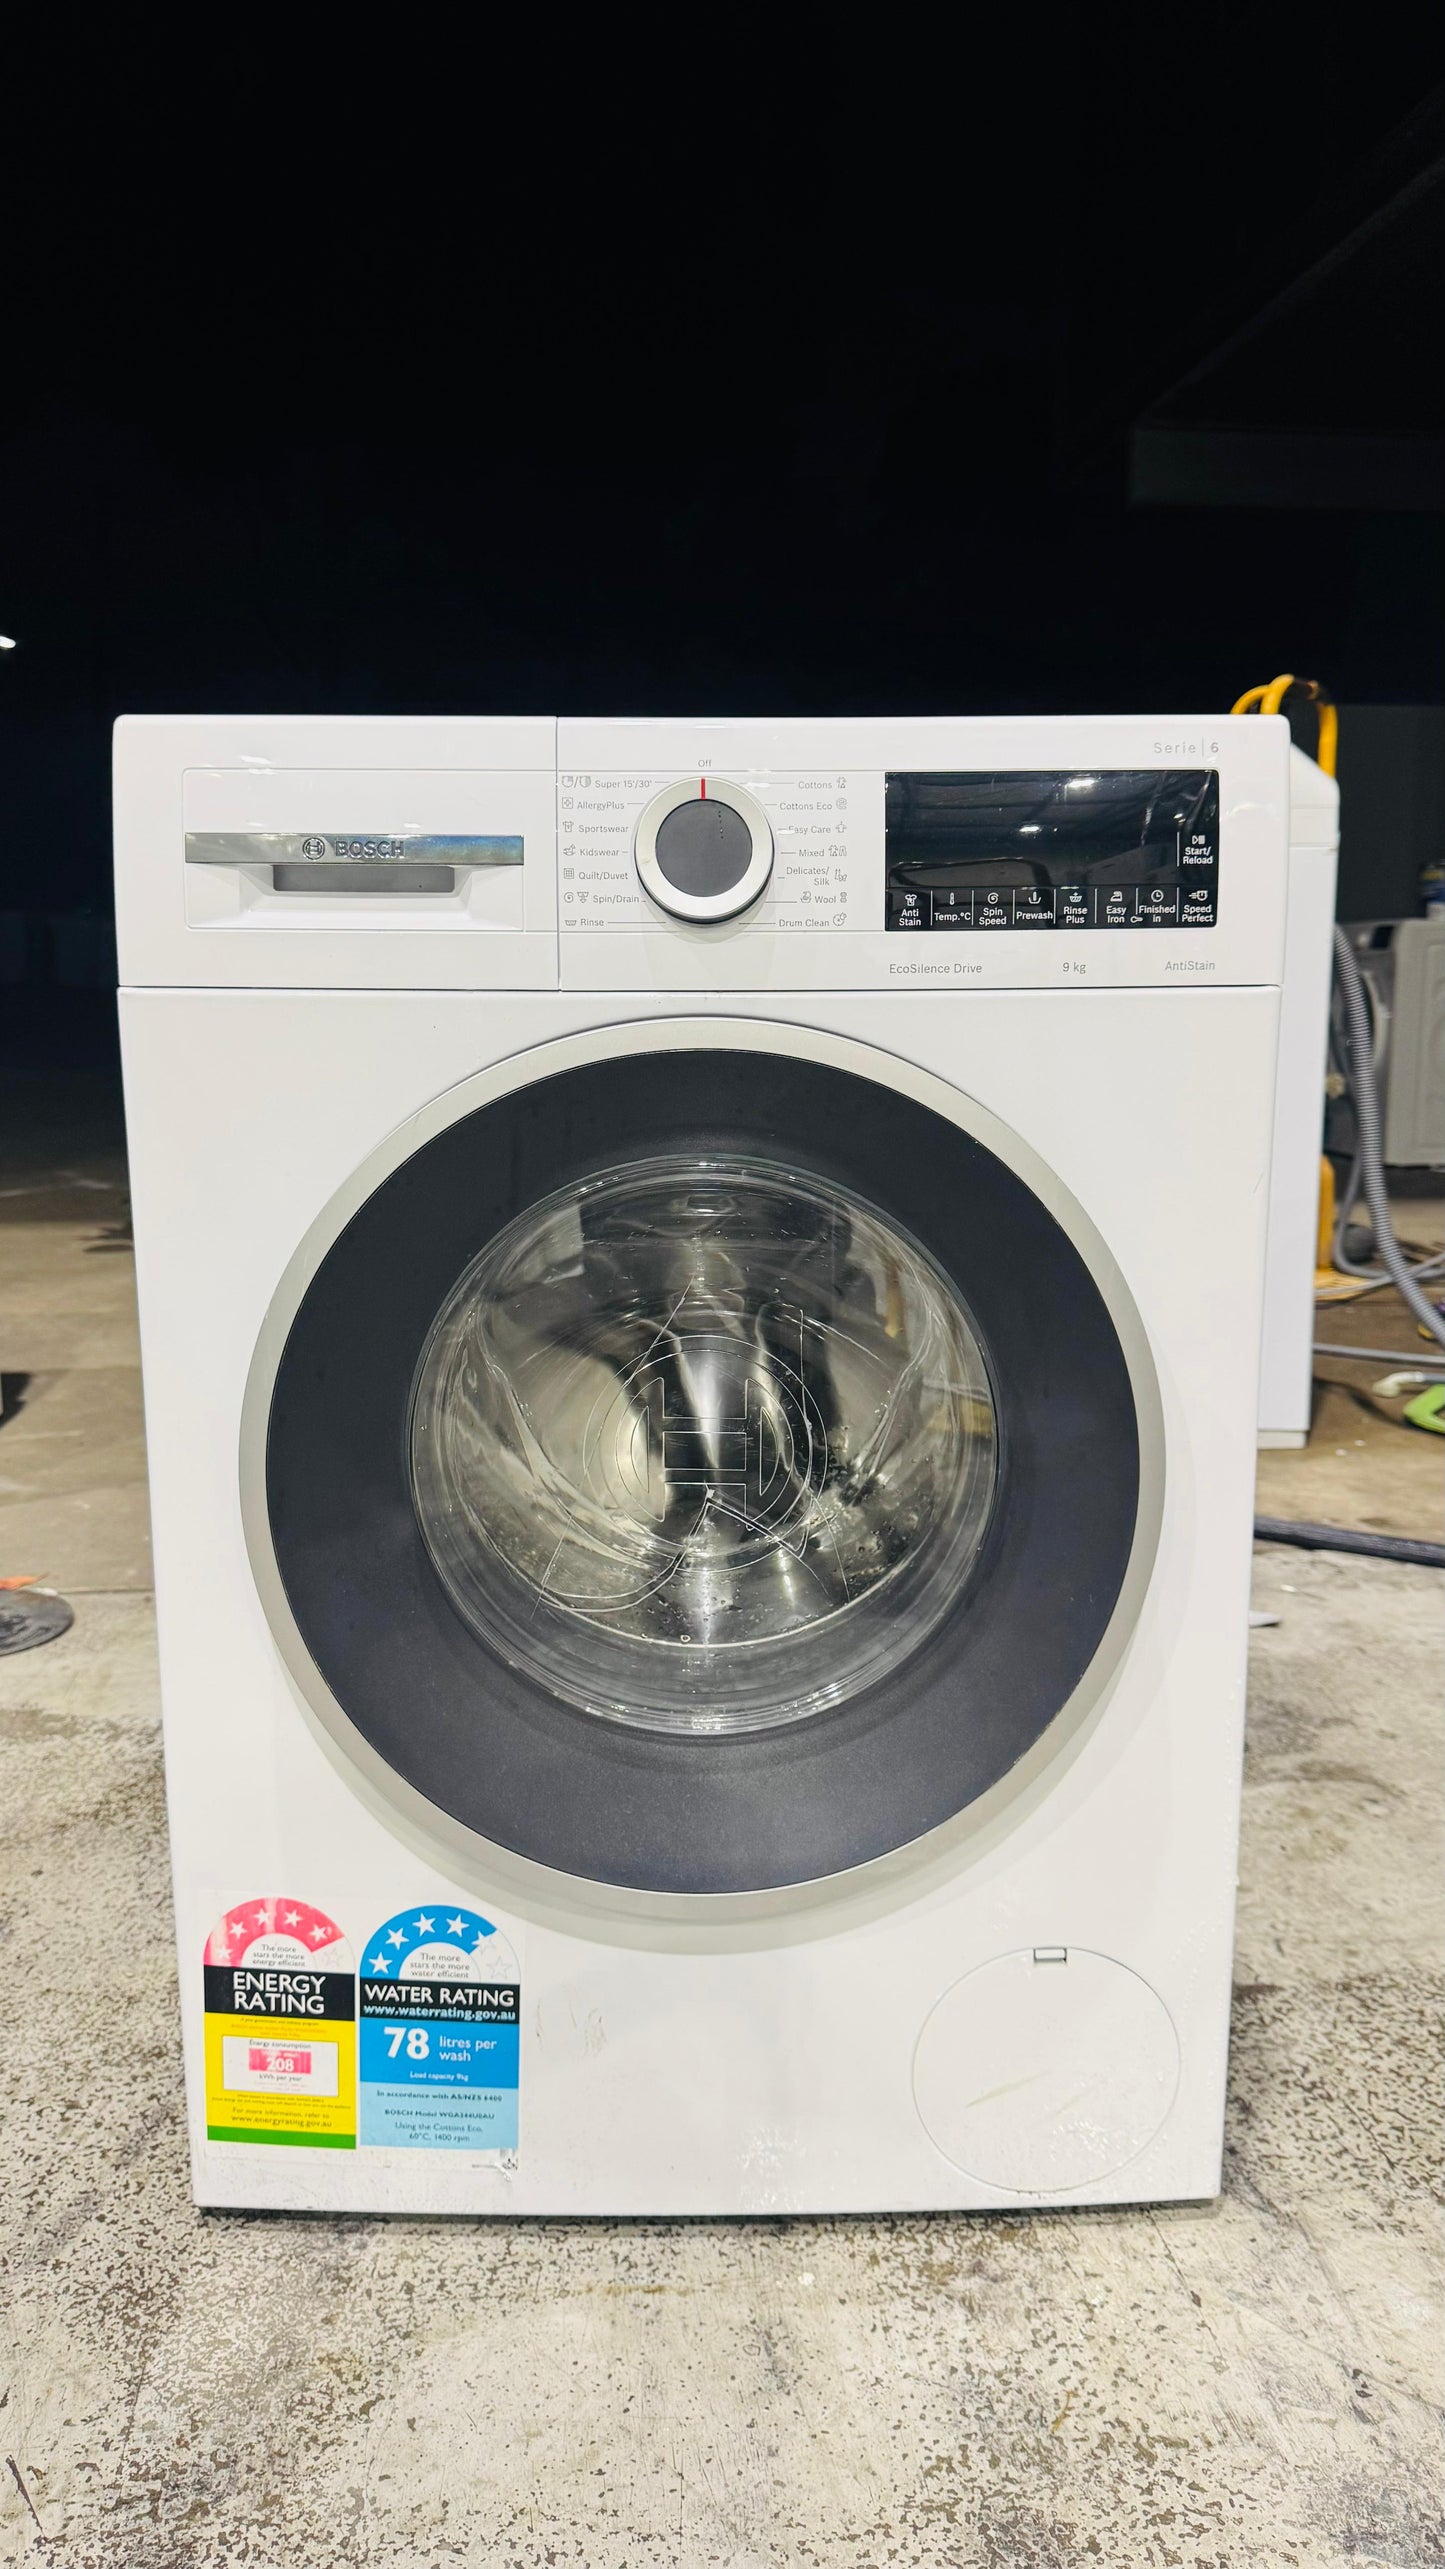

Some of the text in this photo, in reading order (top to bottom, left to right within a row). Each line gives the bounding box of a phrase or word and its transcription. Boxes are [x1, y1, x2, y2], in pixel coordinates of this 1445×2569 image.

[1153, 742, 1219, 754] Serie 6
[697, 759, 712, 768] Off
[595, 780, 620, 789] Super
[798, 781, 832, 789] Cottons
[577, 801, 625, 811] AllergyPlus
[779, 802, 832, 810] Cottons Eco
[578, 824, 629, 834] Sportswear
[811, 825, 831, 834] Care
[335, 840, 404, 858] BOSCH
[580, 848, 619, 857] Kidswear
[799, 849, 825, 857] Mixed
[1185, 847, 1211, 856] Start/
[1182, 856, 1213, 865] Reload
[578, 871, 629, 881] Quilt/Duvet
[786, 866, 830, 876] Delicates/
[814, 877, 830, 886] Silk
[592, 894, 640, 905] Spin/Drain
[814, 895, 837, 904] Wool
[901, 908, 919, 918] Anti
[983, 907, 1003, 918] Spin
[1063, 906, 1088, 915] Rinse
[1106, 905, 1127, 915] Easy
[1138, 905, 1176, 914] Finished
[1183, 904, 1212, 915] Speed
[1016, 911, 1054, 921] Prewash
[1065, 915, 1085, 924] Plus
[1107, 915, 1125, 924] Iron
[1152, 914, 1162, 923] in
[1181, 914, 1214, 923] Perfect
[580, 918, 605, 927] Rinse
[778, 918, 830, 927] Drum Clean
[898, 917, 922, 926] Stain
[978, 916, 1007, 927] Speed
[889, 963, 983, 974] EcoSilence Drive
[1062, 962, 1086, 974] 9 kg
[1164, 961, 1216, 971] AntiStain
[261, 1943, 275, 1952] The
[253, 1951, 270, 1959] stars
[271, 1951, 283, 1960] the
[420, 1952, 460, 1962] The more
[252, 1959, 276, 1967] energy
[410, 1961, 470, 1971] stars the more
[437, 1970, 469, 1979] efficient
[233, 1971, 326, 1995] ENERGY
[364, 1983, 514, 2008] WATER RATING
[234, 1990, 325, 2015] RATING
[363, 2004, 515, 2021] www.waterrating.gov.au
[249, 2039, 270, 2048] Energy
[384, 2026, 430, 2060] 78
[439, 2036, 497, 2052] litres per
[439, 2049, 471, 2062] wash
[266, 2057, 295, 2072] 208
[410, 2071, 427, 2079] Load
[428, 2072, 454, 2081] capacity
[231, 2115, 332, 2128] www.energyrating.gov.au
[395, 2121, 417, 2131] Using
